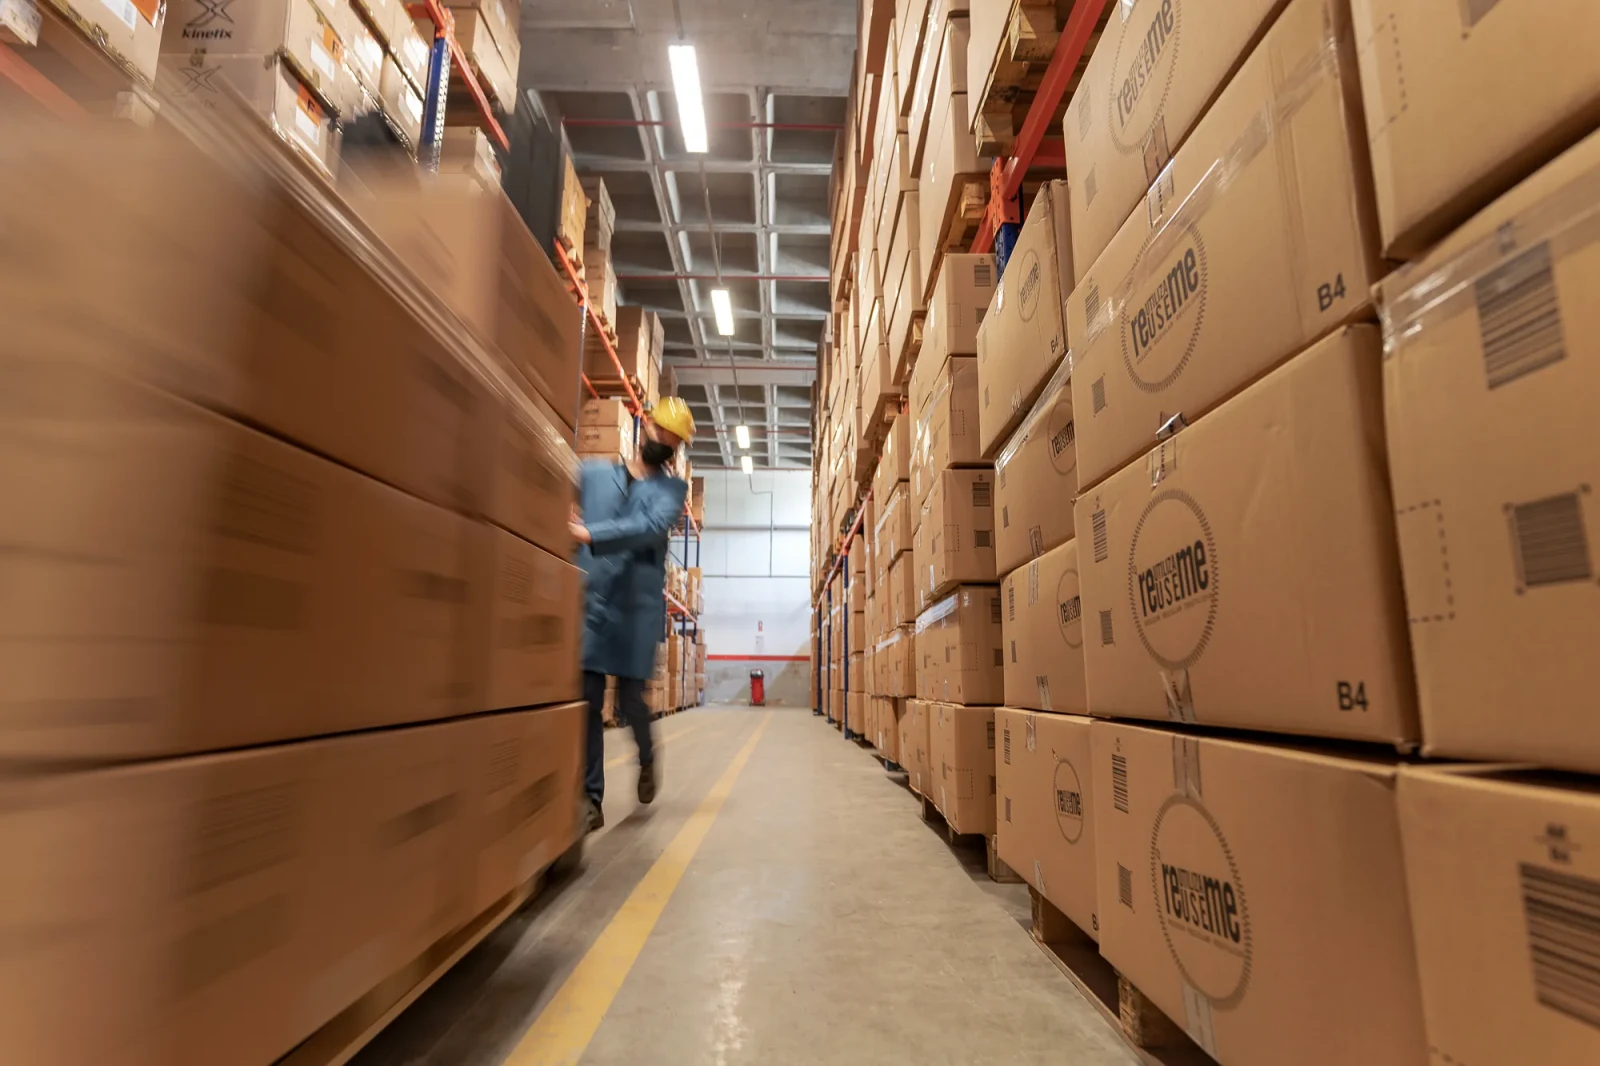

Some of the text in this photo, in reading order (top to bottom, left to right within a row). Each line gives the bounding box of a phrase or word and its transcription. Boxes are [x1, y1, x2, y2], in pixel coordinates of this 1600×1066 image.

[307, 98, 316, 113] F
[1316, 271, 1347, 312] B4
[1336, 680, 1370, 713] B4
